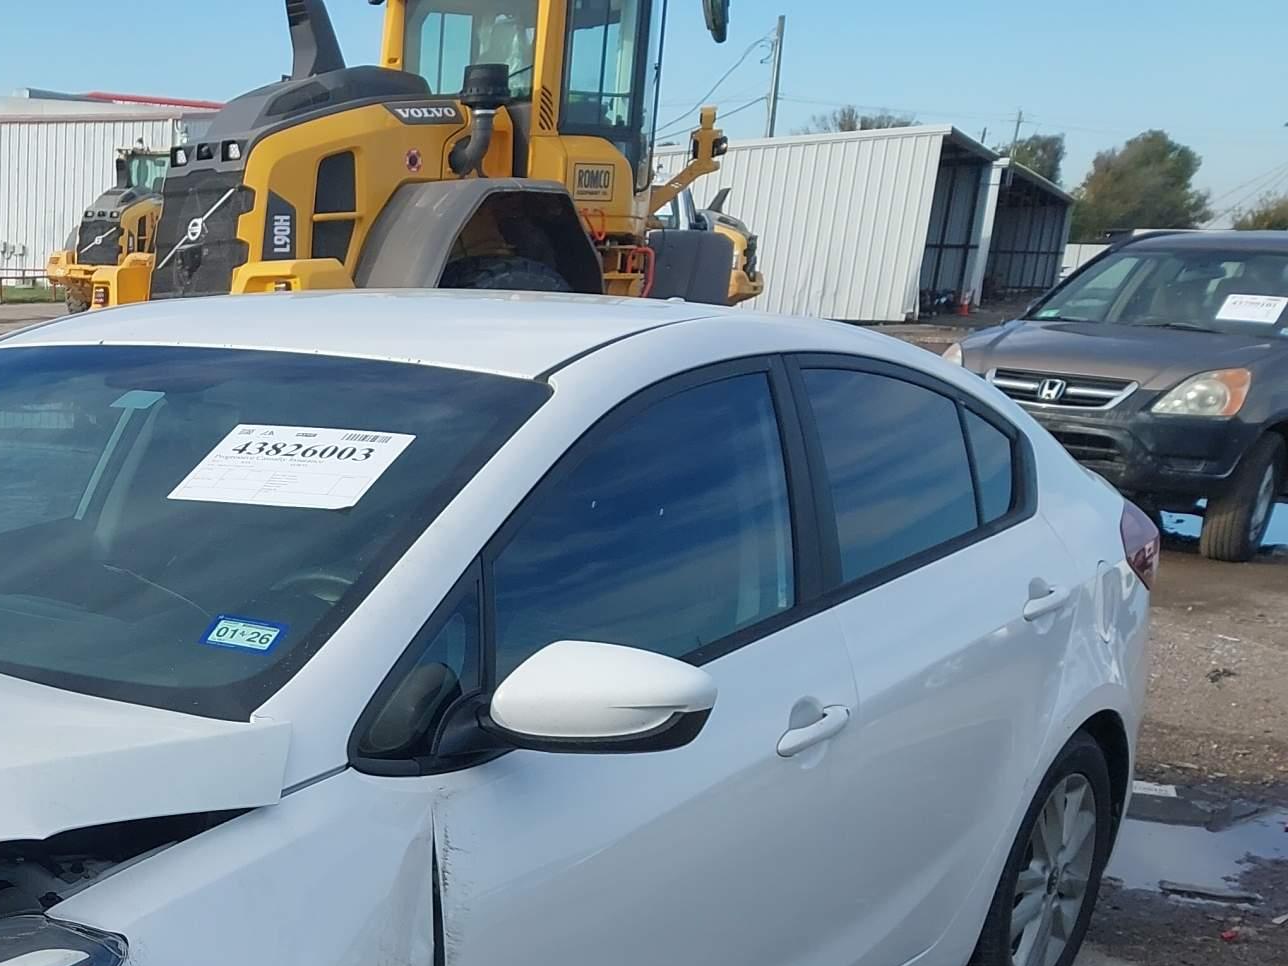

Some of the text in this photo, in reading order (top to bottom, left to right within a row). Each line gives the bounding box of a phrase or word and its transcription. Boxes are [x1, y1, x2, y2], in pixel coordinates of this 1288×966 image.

[395, 107, 456, 118] VOLVO
[578, 169, 610, 188] ROMCO
[274, 215, 291, 252] L90H
[232, 441, 375, 461] 43826003
[216, 626, 239, 639] 01
[246, 631, 273, 645] 26
